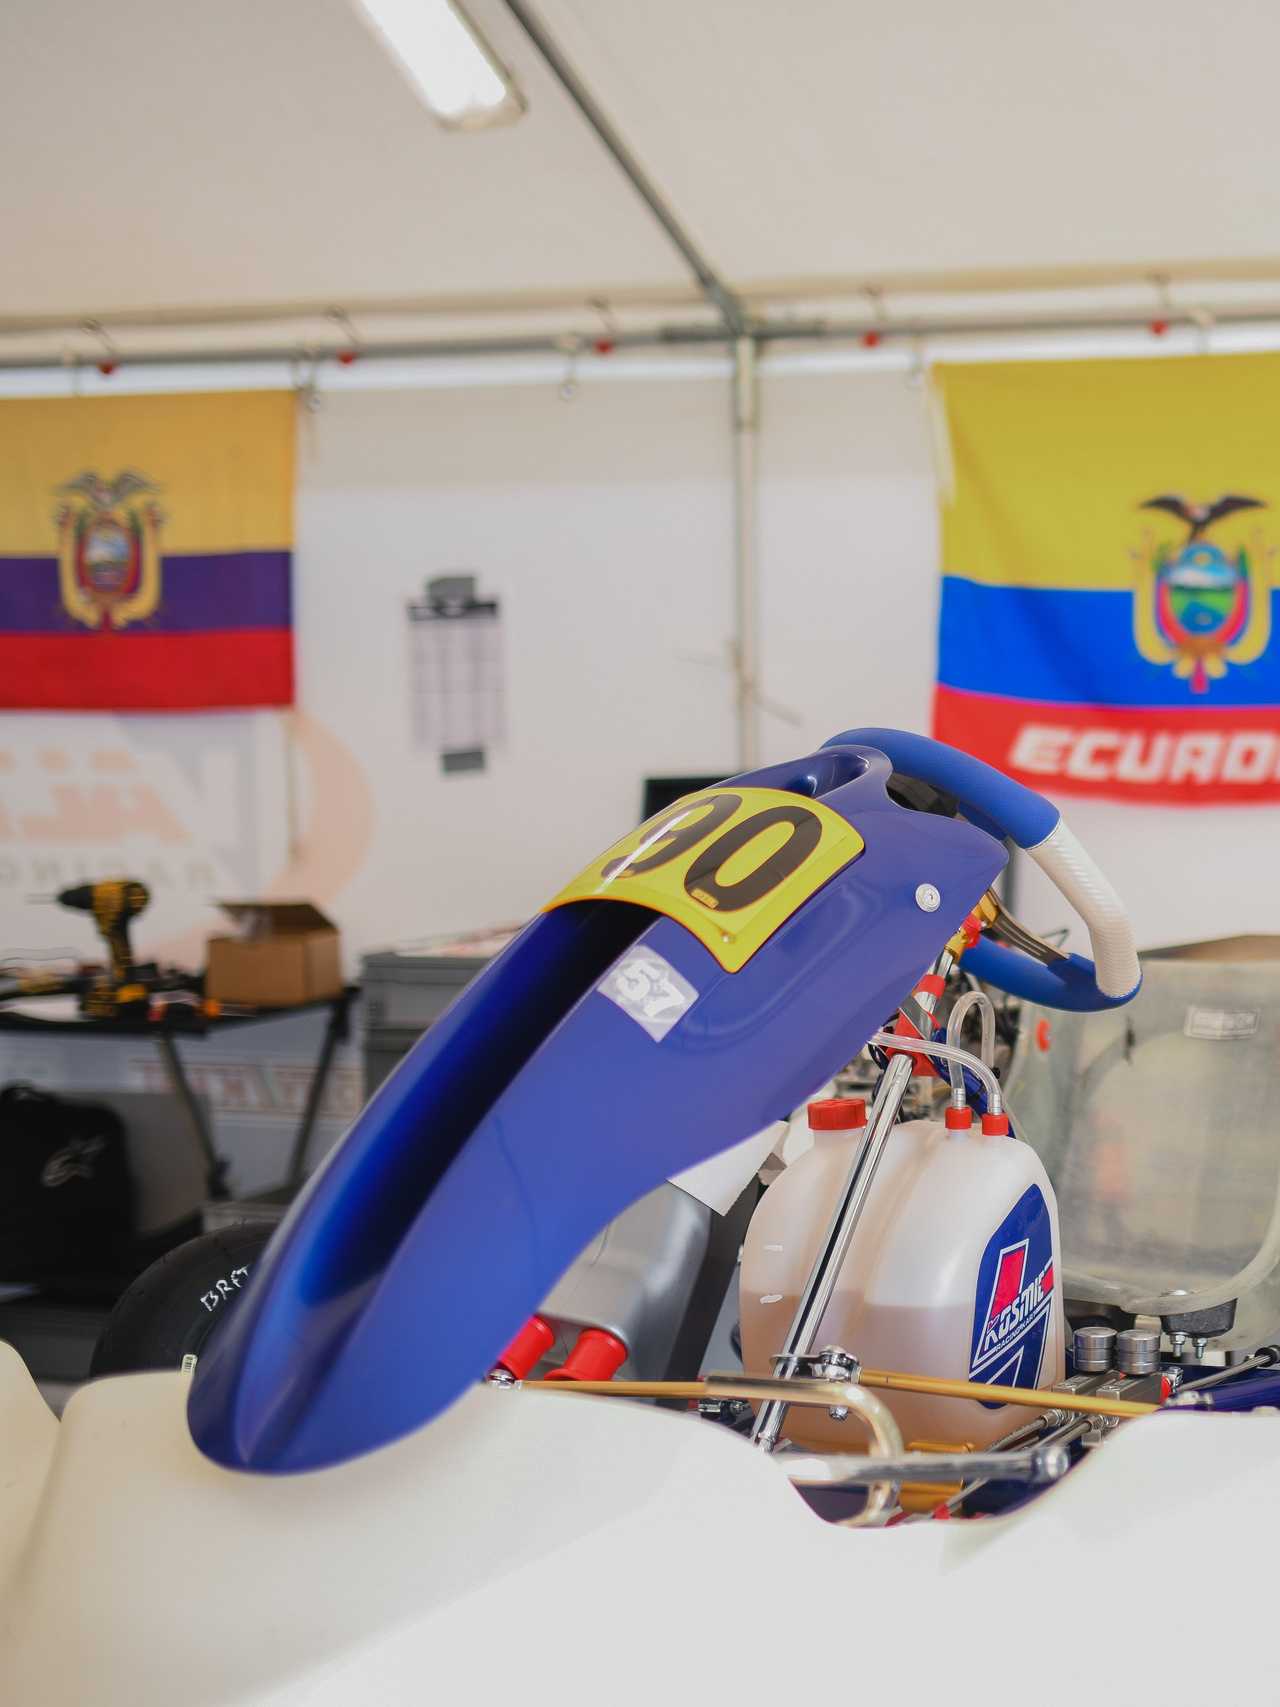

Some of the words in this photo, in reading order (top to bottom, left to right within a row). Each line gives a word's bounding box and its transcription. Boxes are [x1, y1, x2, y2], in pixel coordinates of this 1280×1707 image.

[600, 793, 823, 913] 90
[615, 958, 686, 1018] 57
[984, 1270, 1045, 1351] KOSMIC
